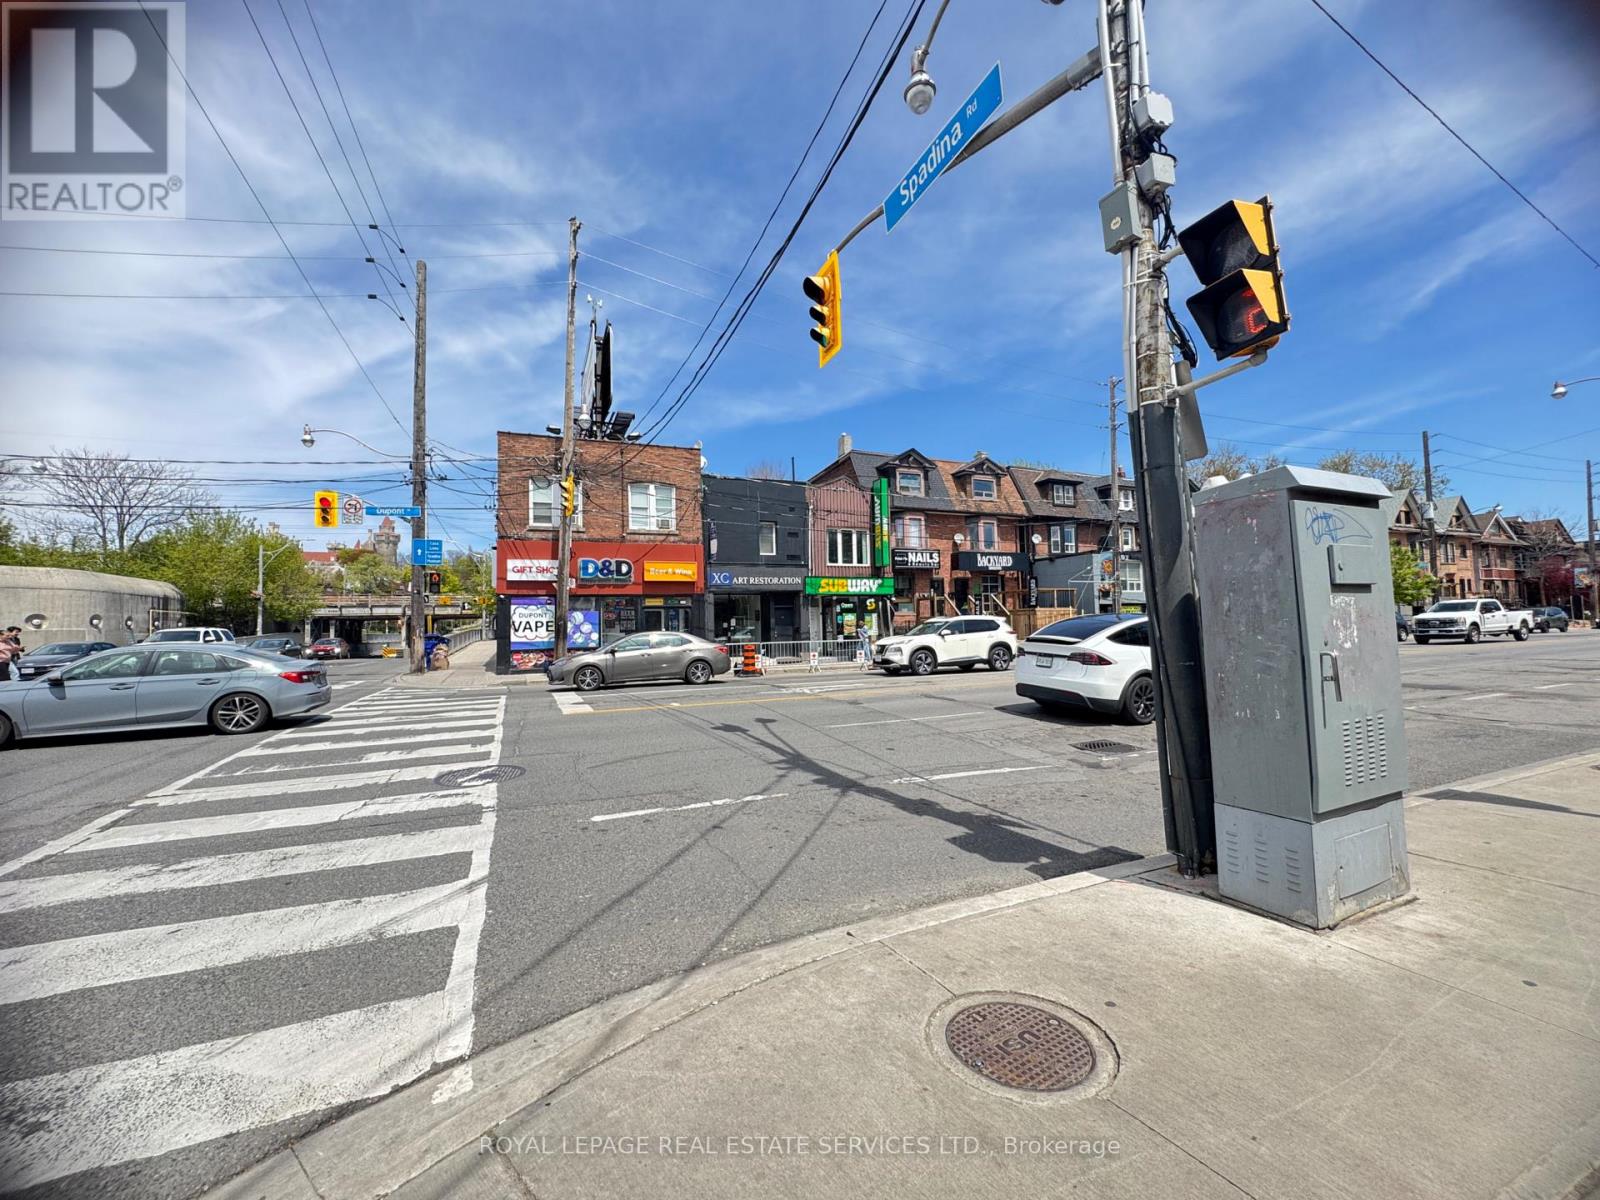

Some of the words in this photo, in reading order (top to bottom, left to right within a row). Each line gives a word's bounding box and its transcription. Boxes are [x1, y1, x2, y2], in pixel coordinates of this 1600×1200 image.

[900, 122, 962, 206] Spadina
[966, 98, 978, 118] Rd
[376, 506, 405, 516] Dupont
[907, 552, 939, 562] NAILS
[976, 553, 1013, 567] BACKYARD
[512, 566, 533, 574] GIFT
[580, 558, 633, 578] D&D
[712, 573, 730, 584] XC
[819, 578, 878, 593] SUBWAY
[511, 620, 555, 633] VAPE
